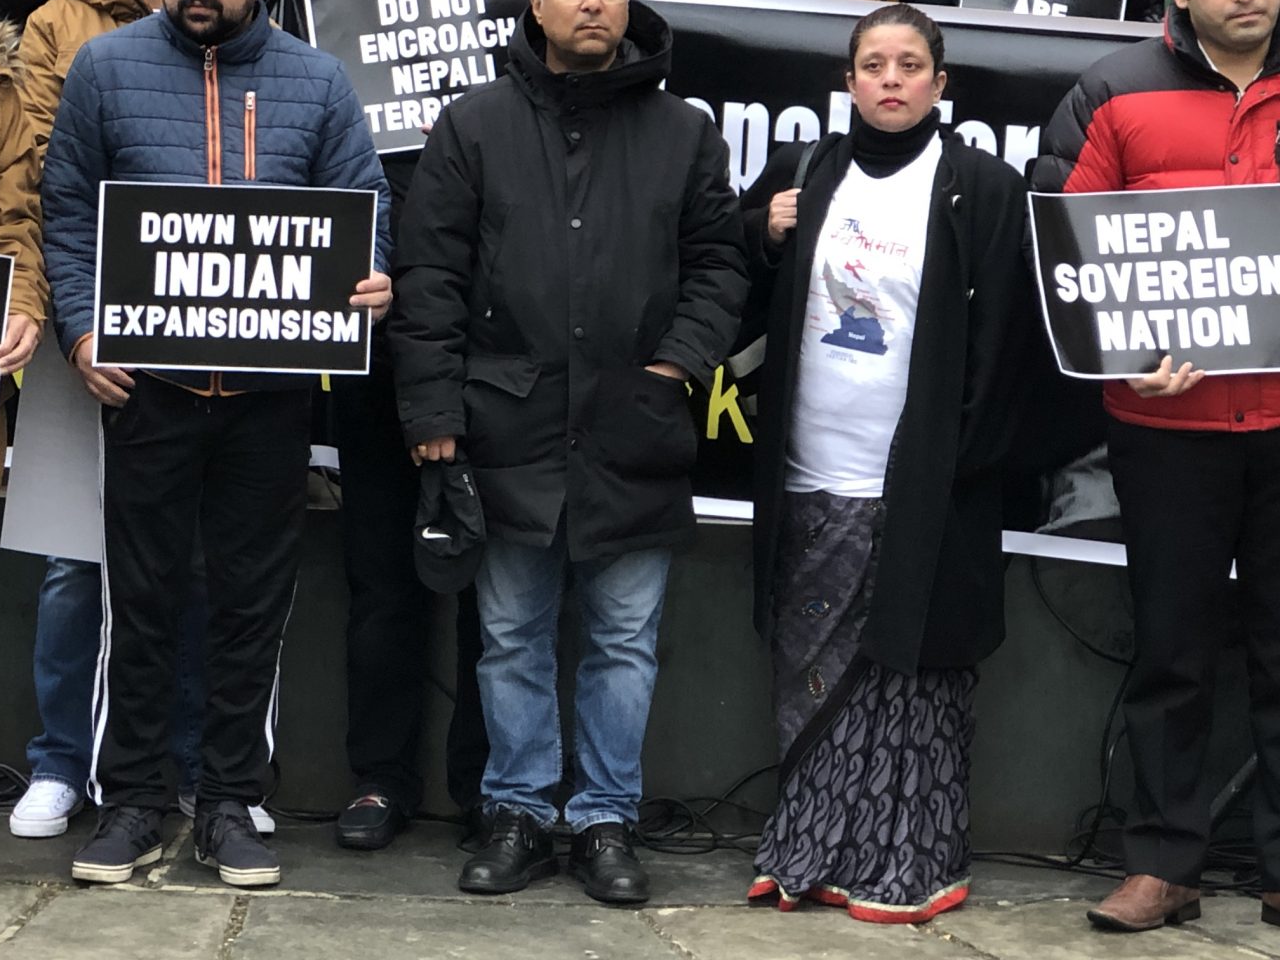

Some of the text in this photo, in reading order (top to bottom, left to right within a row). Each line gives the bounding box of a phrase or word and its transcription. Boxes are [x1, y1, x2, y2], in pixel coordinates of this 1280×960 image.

[359, 16, 516, 64] ENCROACH
[391, 54, 496, 95] NEPALI
[140, 212, 332, 248] DOWN WITH
[1095, 209, 1230, 255] NEPAL
[154, 251, 312, 301] INDIAN
[1054, 255, 1280, 304] SOVEREIGN
[104, 304, 360, 343] EXPANSIONSISM
[1096, 304, 1251, 352] NATION
